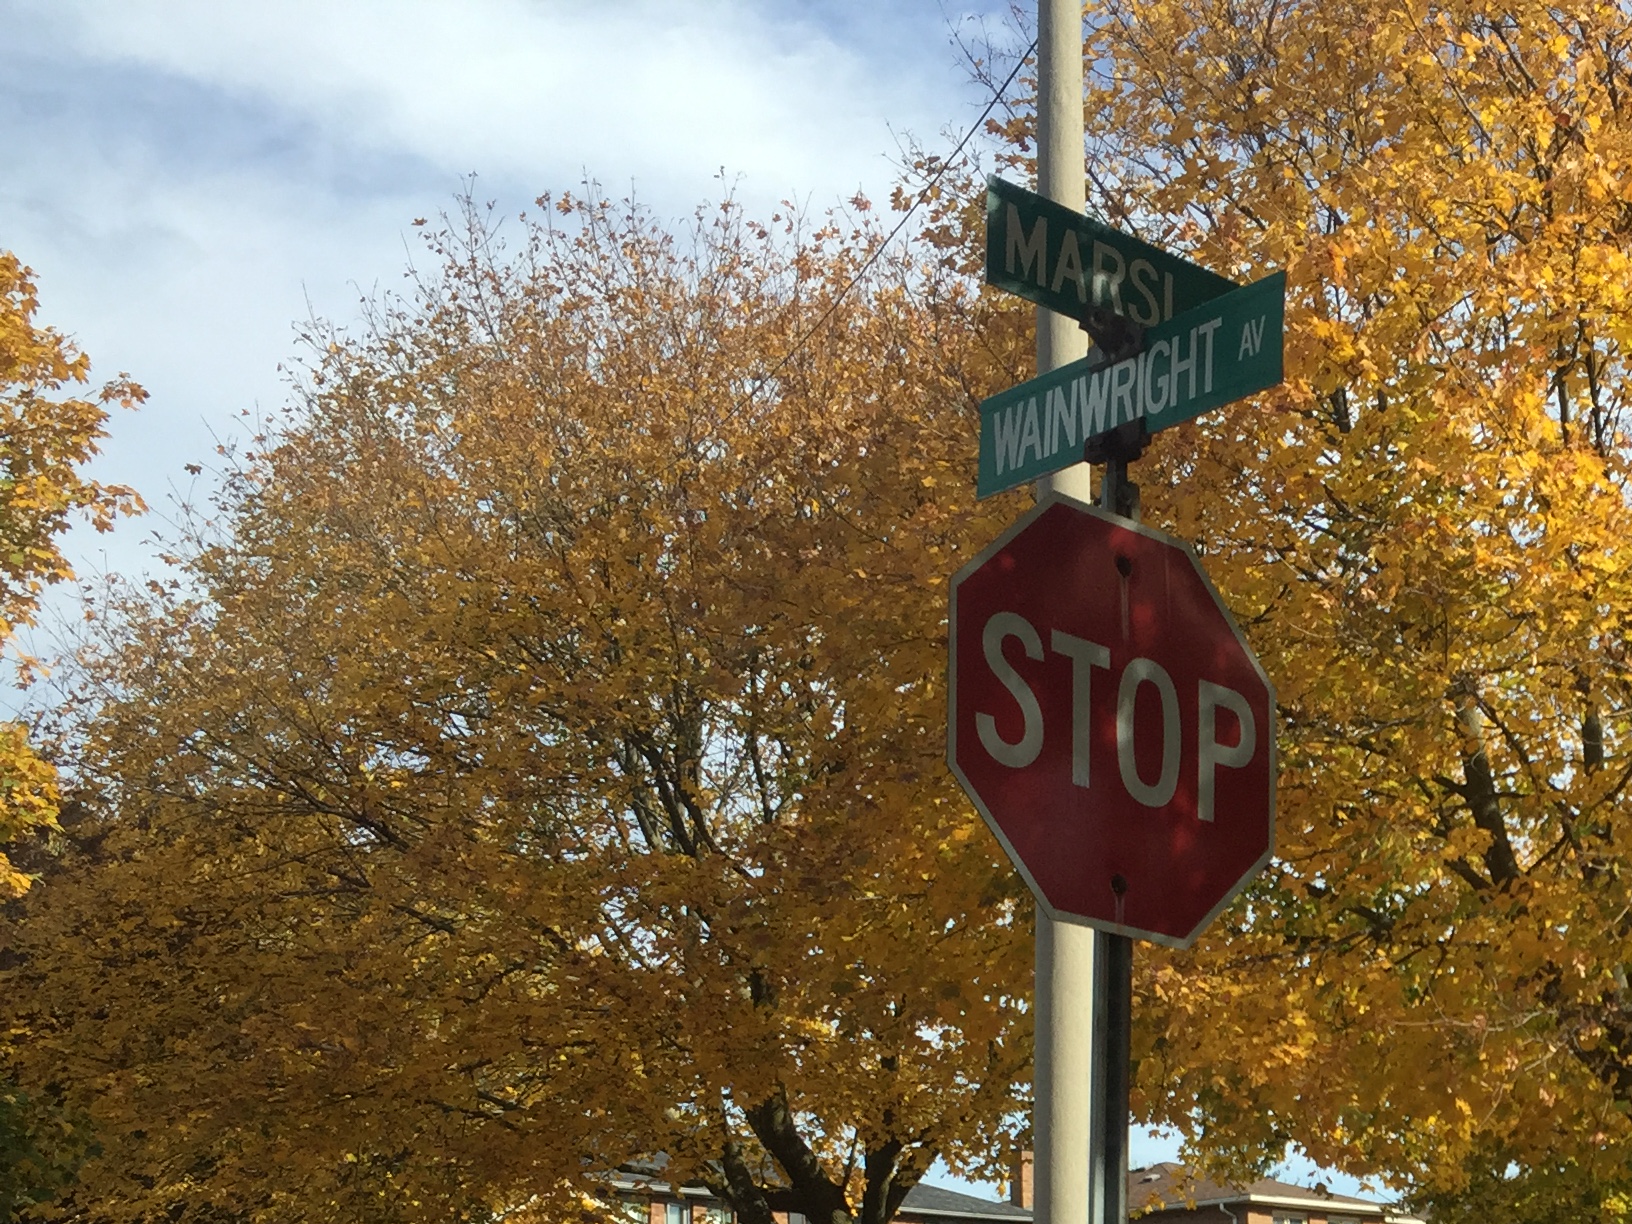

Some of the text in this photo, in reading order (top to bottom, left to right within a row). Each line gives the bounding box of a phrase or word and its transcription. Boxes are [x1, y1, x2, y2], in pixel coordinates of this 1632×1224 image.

[1004, 203, 1174, 328] MARSI
[993, 314, 1267, 476] WAINWRIGHT AV
[975, 611, 1256, 823] STOP
